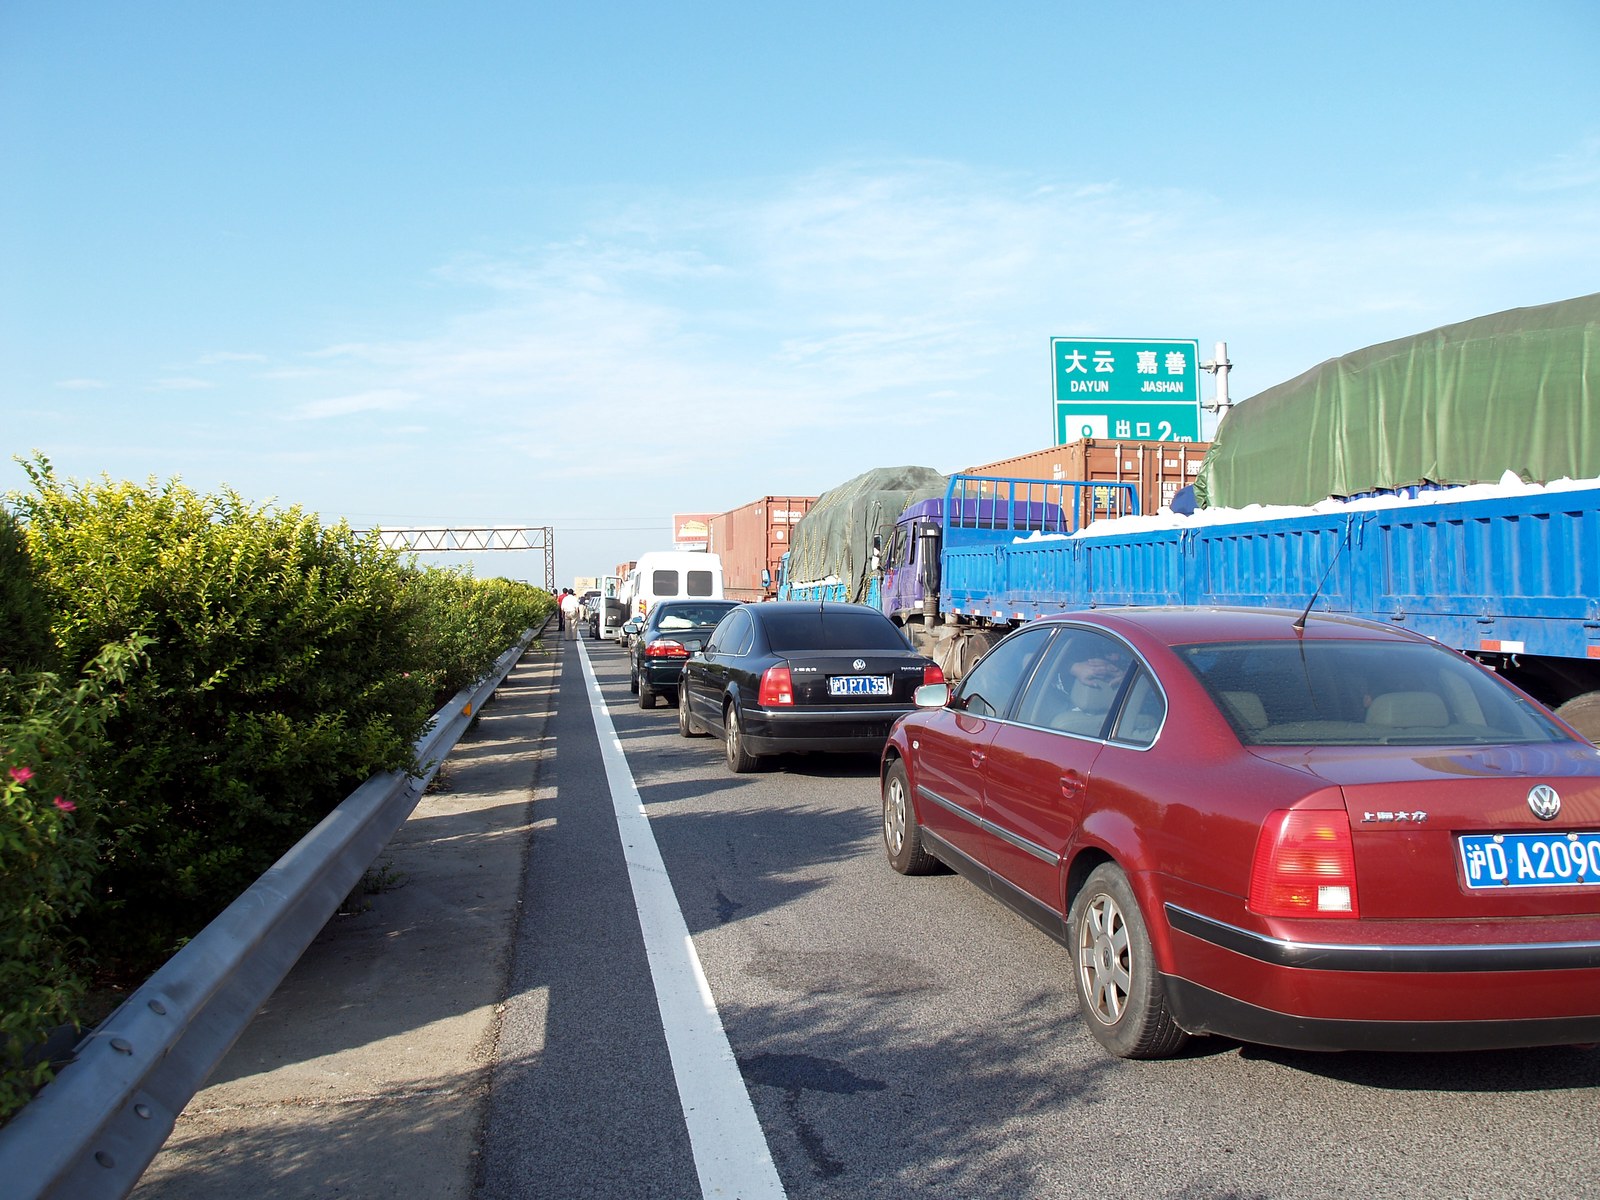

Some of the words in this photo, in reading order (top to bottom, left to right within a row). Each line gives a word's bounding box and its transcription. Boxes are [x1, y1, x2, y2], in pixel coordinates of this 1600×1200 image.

[1064, 349, 1115, 374] 大云
[1136, 350, 1186, 375] 嘉善
[1070, 380, 1109, 393] DAYUN
[1140, 381, 1184, 393] JIASHAN
[1115, 419, 1151, 438] 出口
